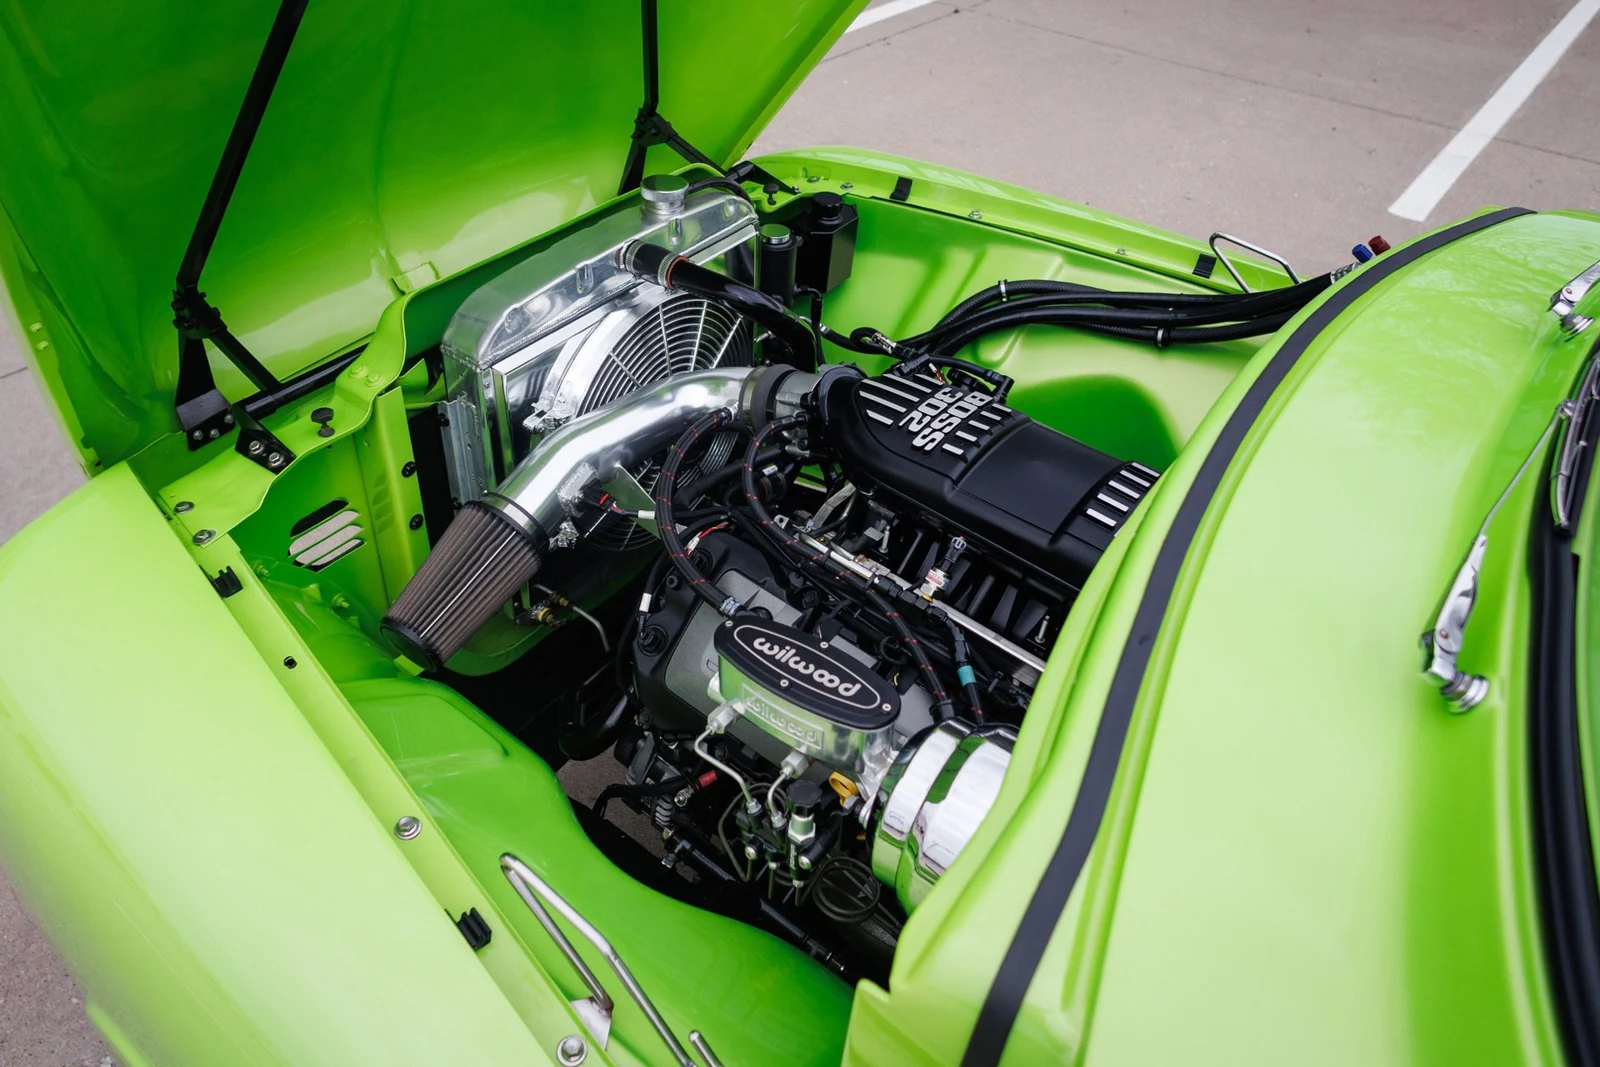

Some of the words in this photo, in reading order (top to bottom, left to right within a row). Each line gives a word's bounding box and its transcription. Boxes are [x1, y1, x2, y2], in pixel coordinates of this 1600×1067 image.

[900, 387, 963, 432] 302
[912, 391, 993, 451] BOSS
[752, 637, 862, 697] wilwood
